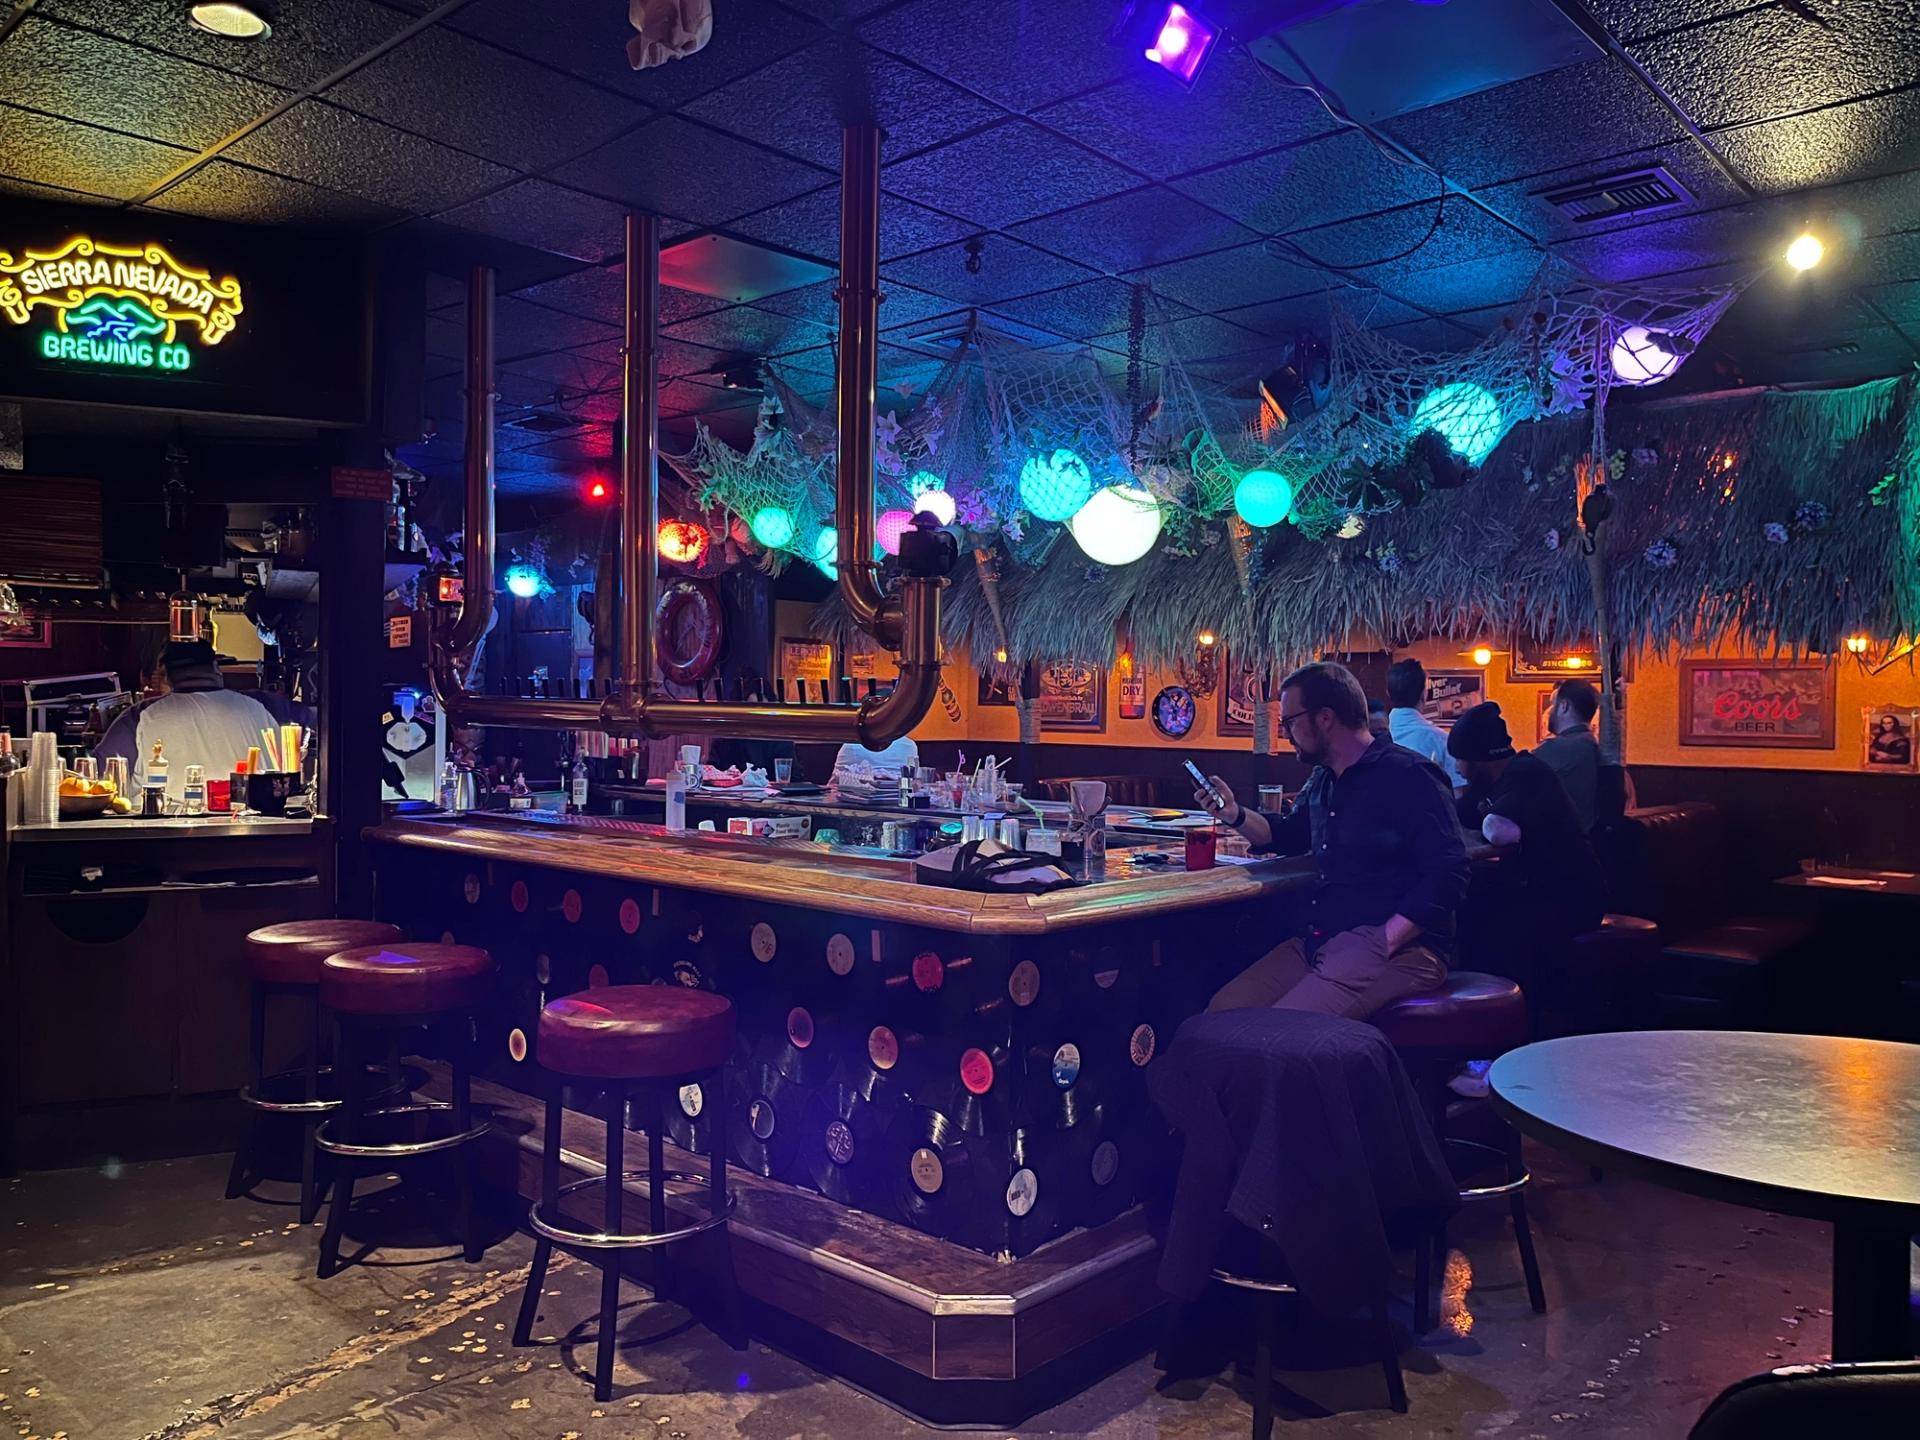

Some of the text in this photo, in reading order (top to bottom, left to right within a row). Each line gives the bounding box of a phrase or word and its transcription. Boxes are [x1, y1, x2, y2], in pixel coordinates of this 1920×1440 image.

[21, 260, 215, 314] SIERRA NEVADA
[43, 335, 190, 371] BREWING CO
[1123, 685, 1141, 696] DRY
[1426, 677, 1448, 690] ilver
[1432, 682, 1462, 699] Bullet
[1714, 689, 1802, 720] Coors
[1734, 721, 1776, 733] BEER
